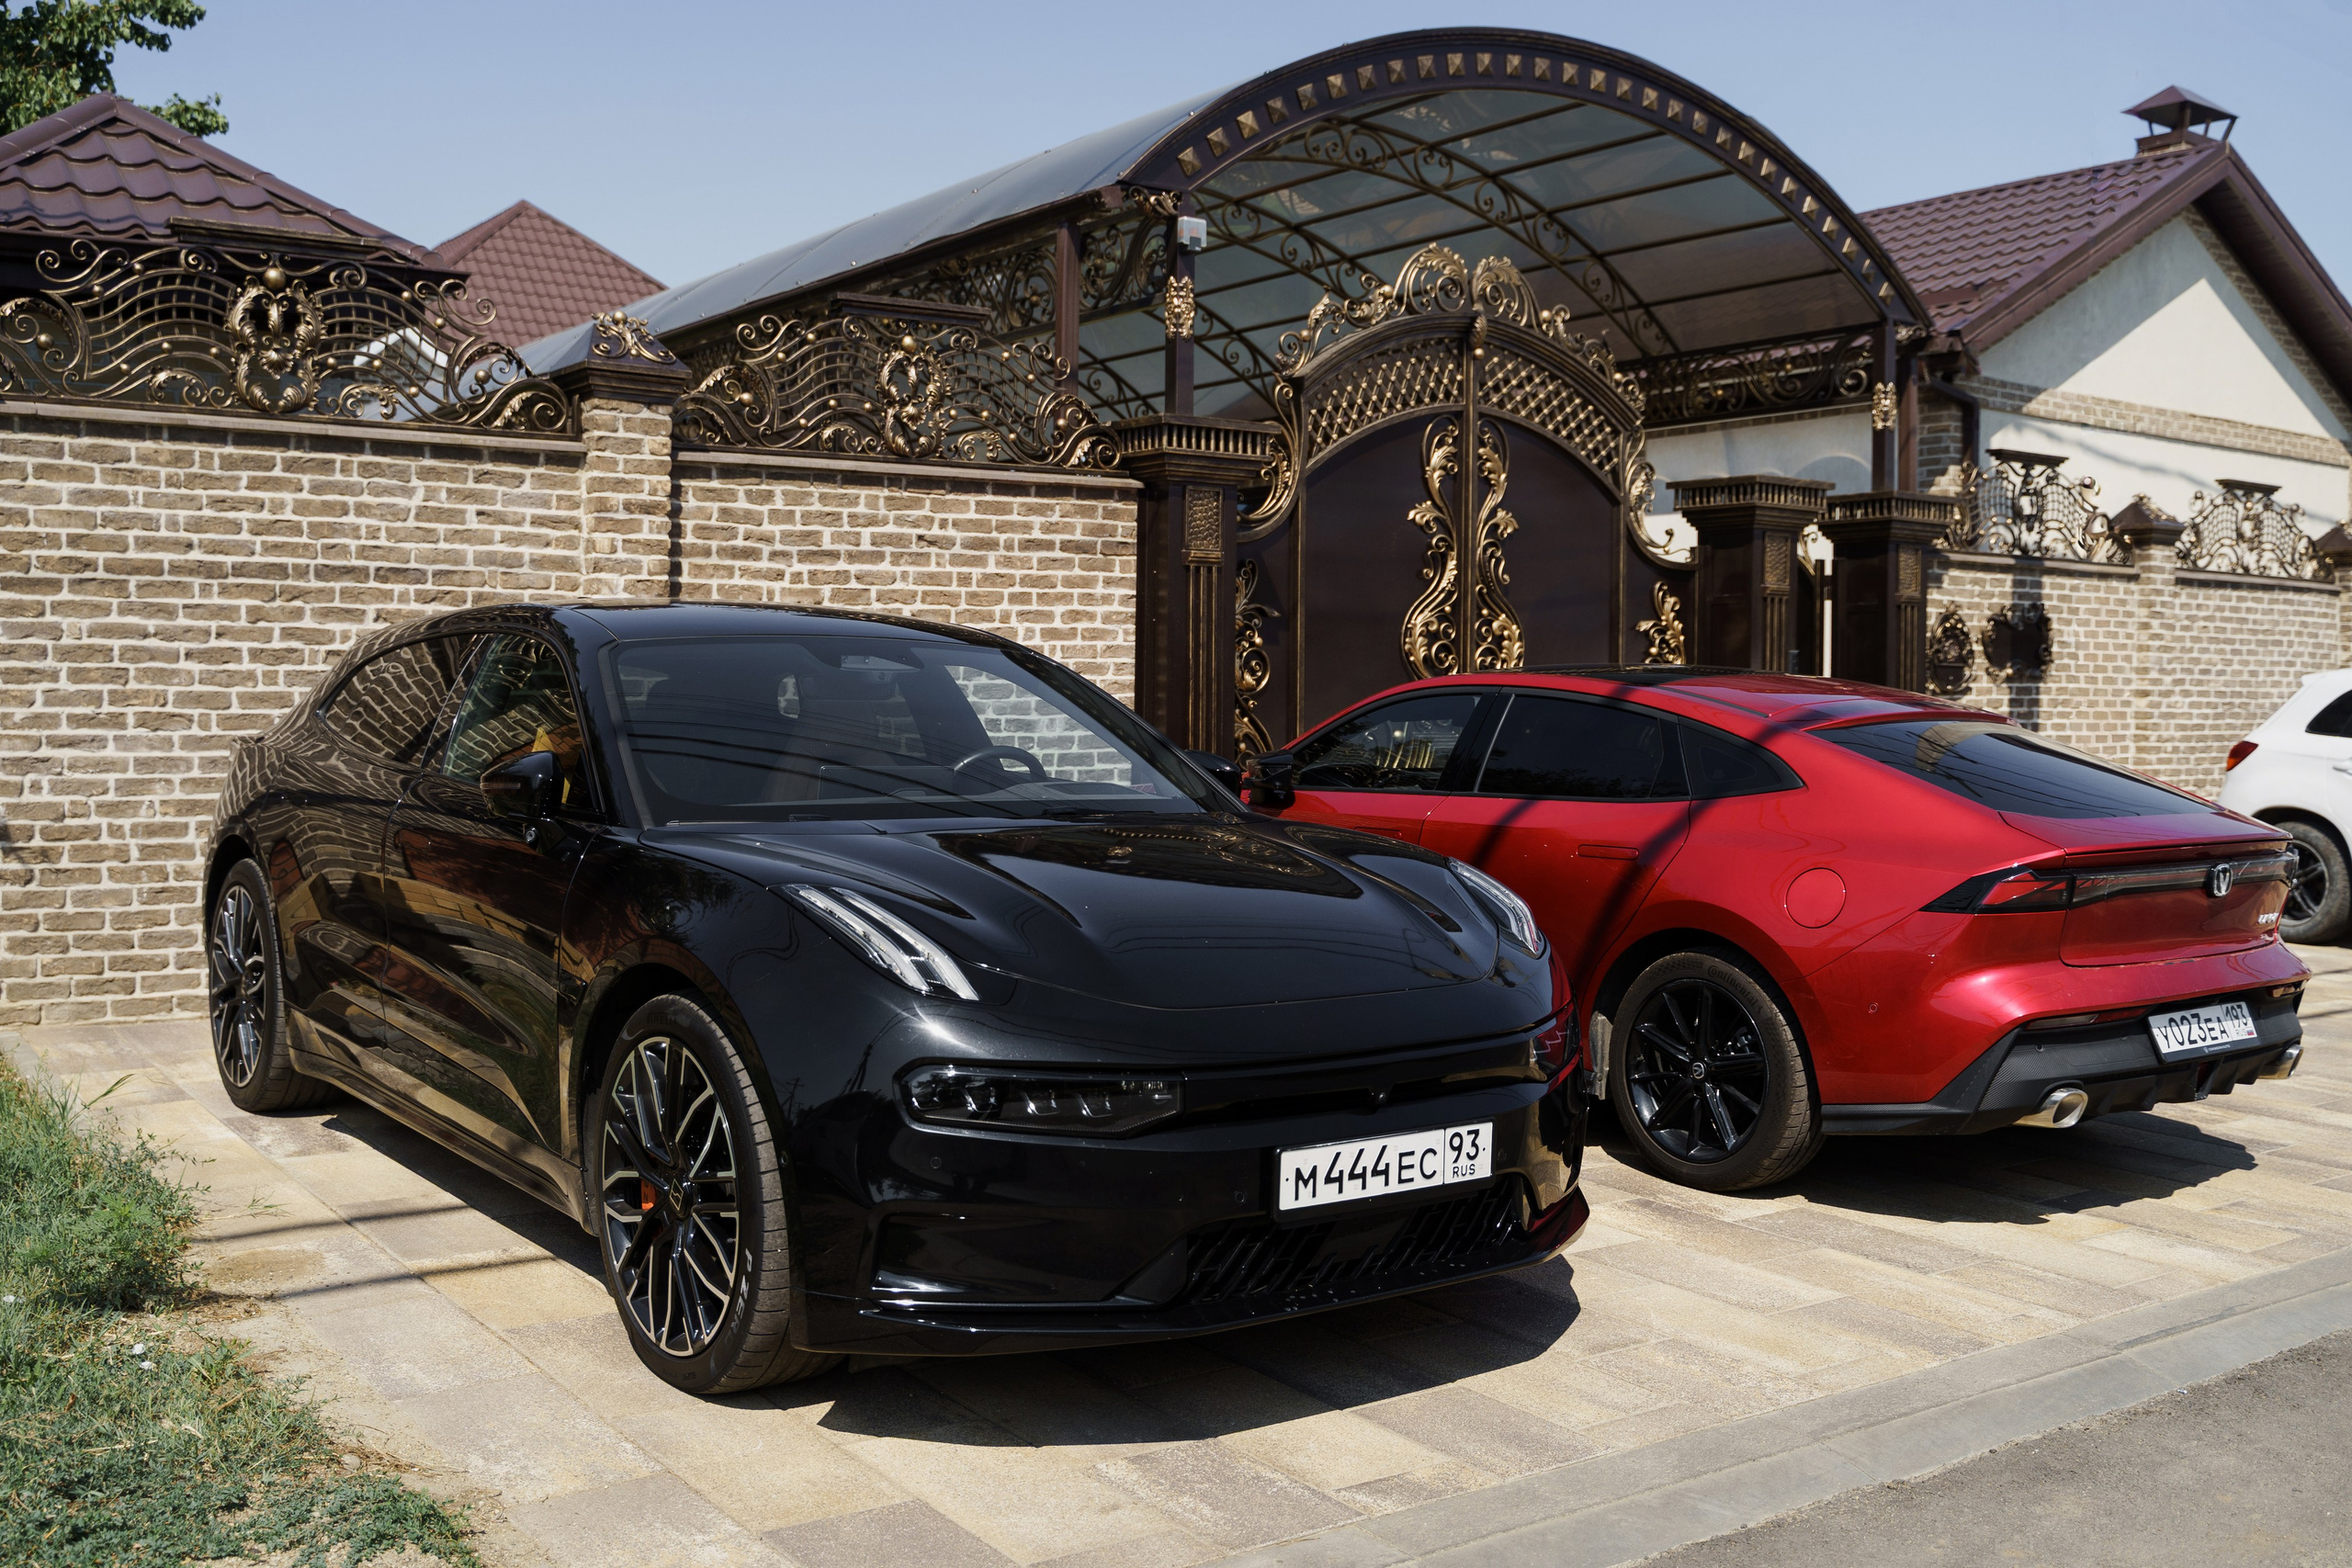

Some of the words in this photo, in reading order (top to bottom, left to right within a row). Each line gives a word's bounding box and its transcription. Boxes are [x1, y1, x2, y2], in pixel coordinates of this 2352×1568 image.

[1707, 964, 1758, 1006] Continental
[647, 1012, 676, 1025] PIRELLI
[2225, 1004, 2248, 1028] 193
[1449, 1128, 1480, 1164] 93
[1452, 1163, 1476, 1179] RUS
